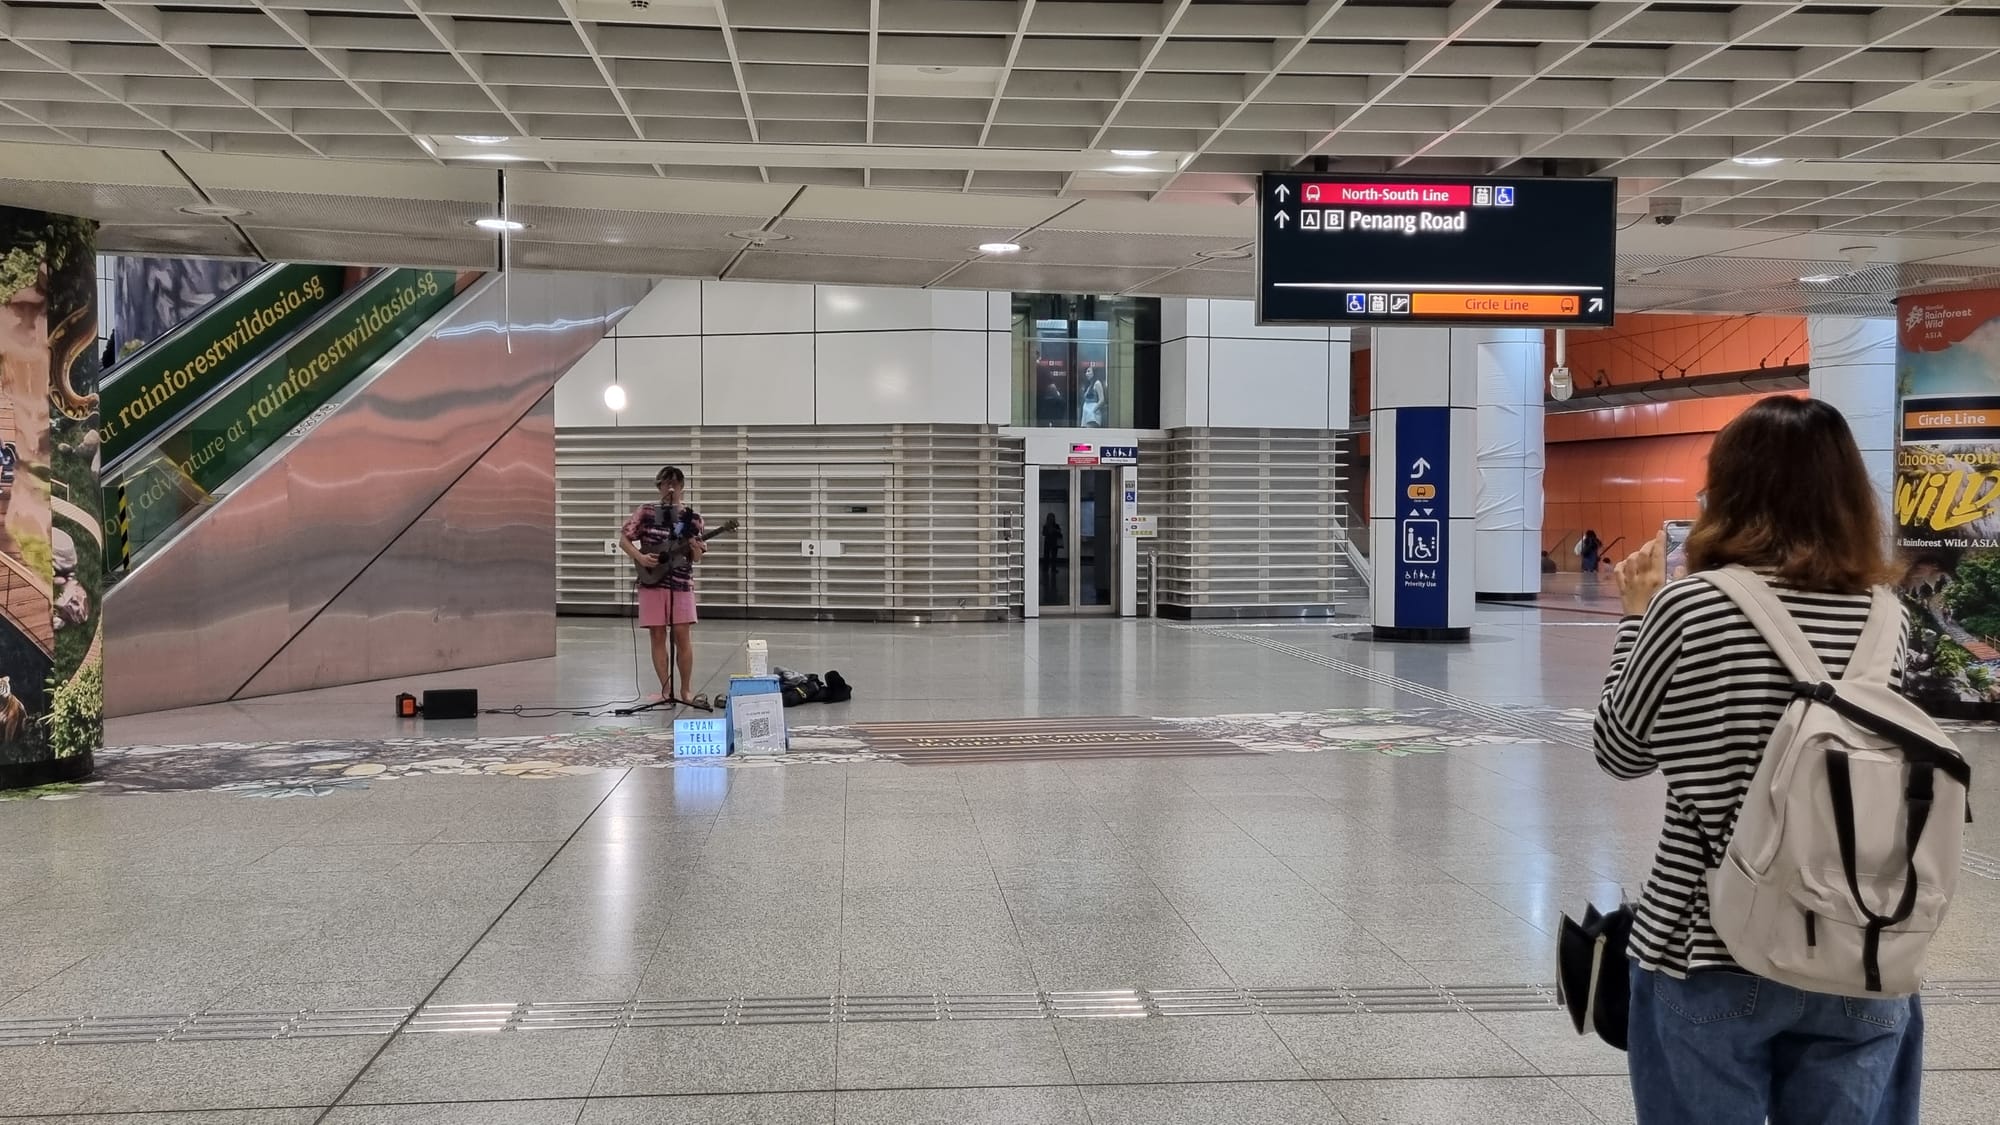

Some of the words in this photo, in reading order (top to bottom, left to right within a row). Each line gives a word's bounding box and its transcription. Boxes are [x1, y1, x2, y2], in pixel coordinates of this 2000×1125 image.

[1342, 187, 1419, 201] North-South
[1422, 189, 1449, 202] Line
[1305, 213, 1316, 226] A
[1329, 213, 1339, 226] B
[1349, 210, 1417, 234] Penang
[1420, 210, 1466, 231] Road
[1465, 298, 1499, 311] Circle
[1503, 299, 1529, 311] Line
[1924, 308, 1973, 320] Rainforest
[1924, 319, 1944, 329] Wild
[1924, 331, 1943, 339] ASIA
[118, 275, 324, 429] rainforestwildasia.sg
[227, 420, 247, 442] at
[247, 271, 439, 428] rainforestwildasia.sg
[1918, 413, 1952, 426] Circle
[1954, 412, 1986, 425] Line
[1898, 451, 1946, 466] Choose
[1953, 453, 2000, 465] your
[1903, 538, 1942, 547] Rainforest
[1943, 538, 1968, 548] Wild
[1971, 538, 1999, 548] ASIA
[690, 733, 713, 743] TELL
[679, 744, 721, 755] STORIES
